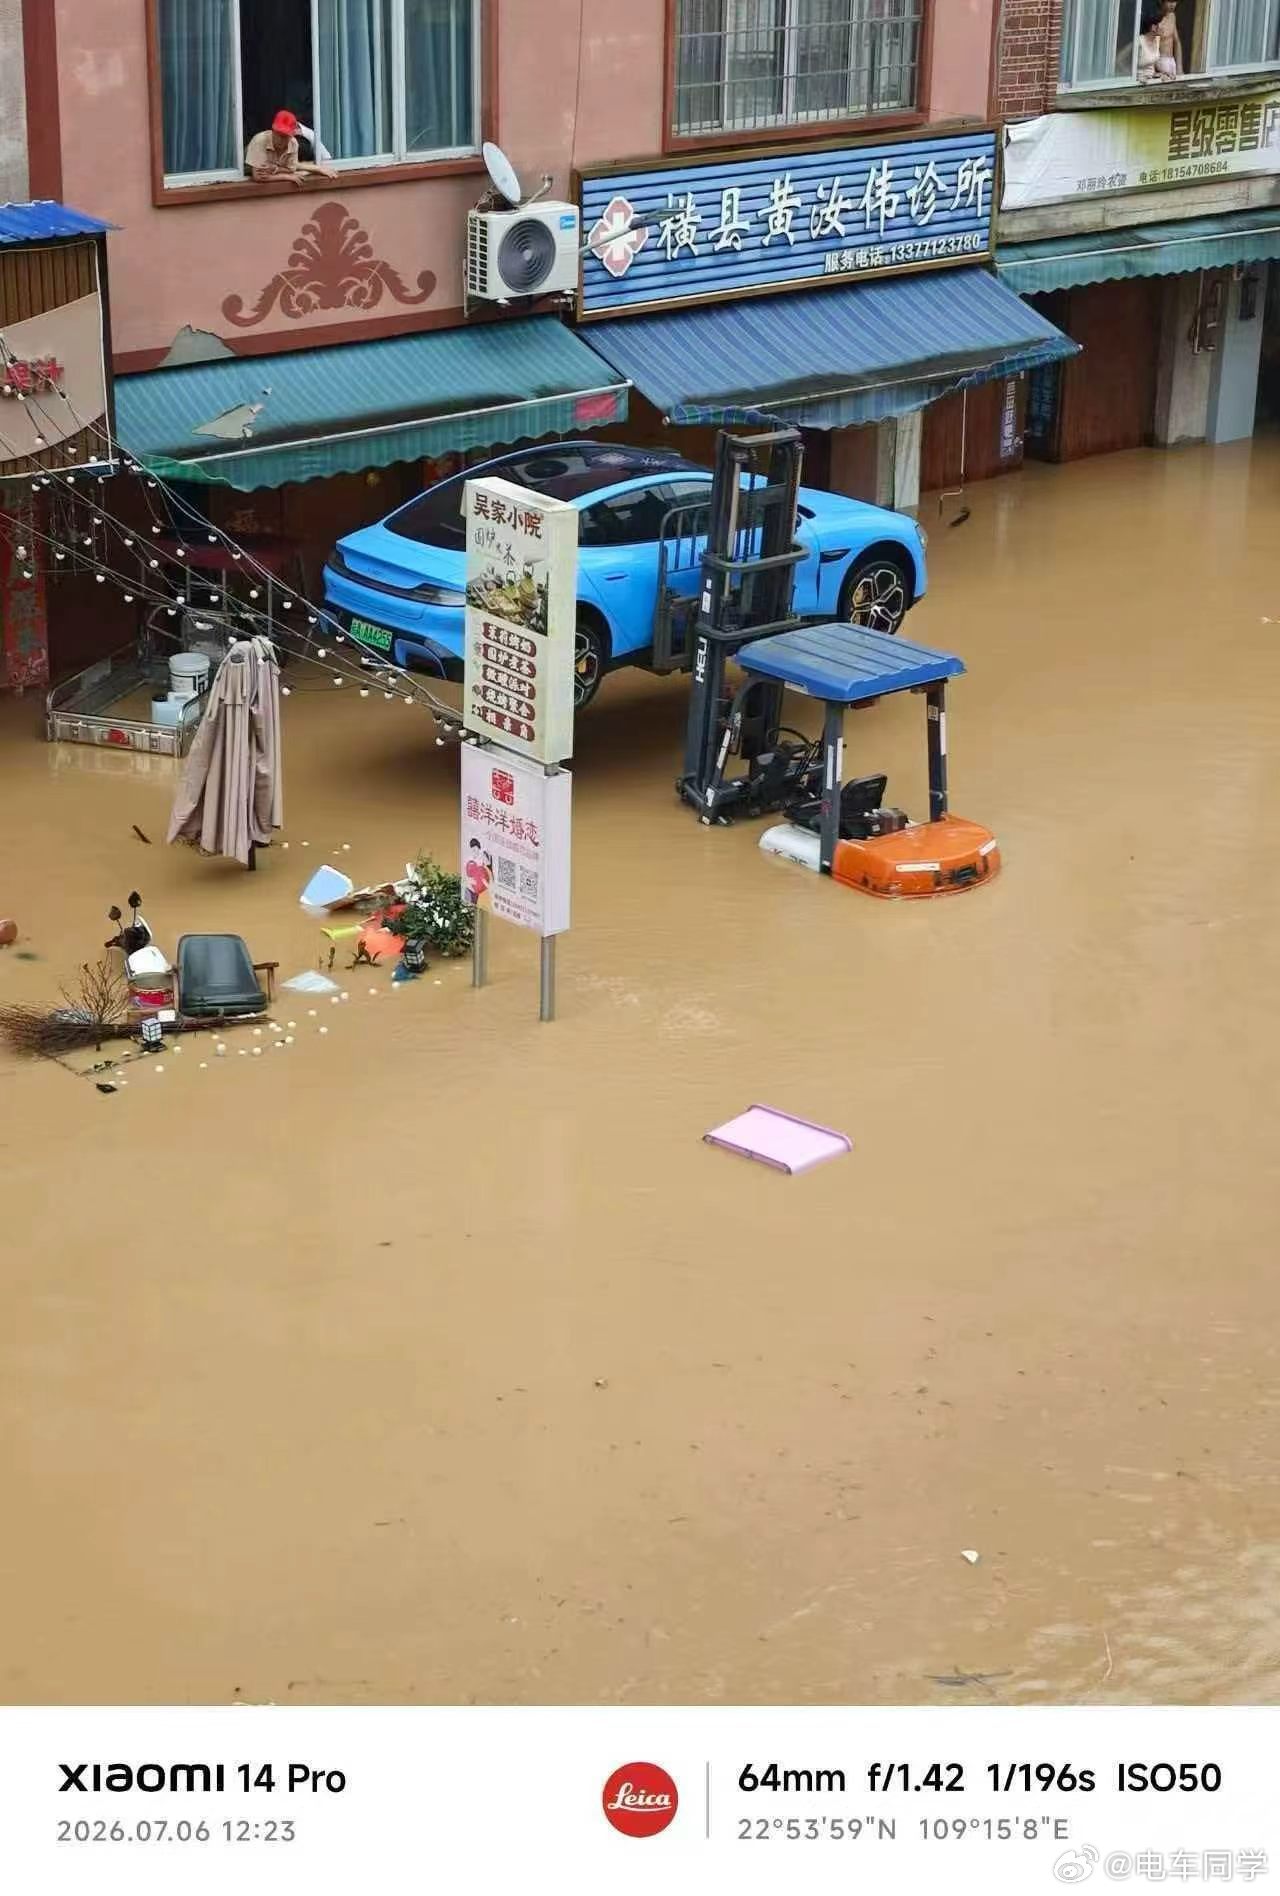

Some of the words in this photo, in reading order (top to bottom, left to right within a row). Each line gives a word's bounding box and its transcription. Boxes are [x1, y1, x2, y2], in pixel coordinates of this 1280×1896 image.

[657, 155, 992, 260] 横县黄汝伟诊所
[474, 492, 544, 539] 吴家小院
